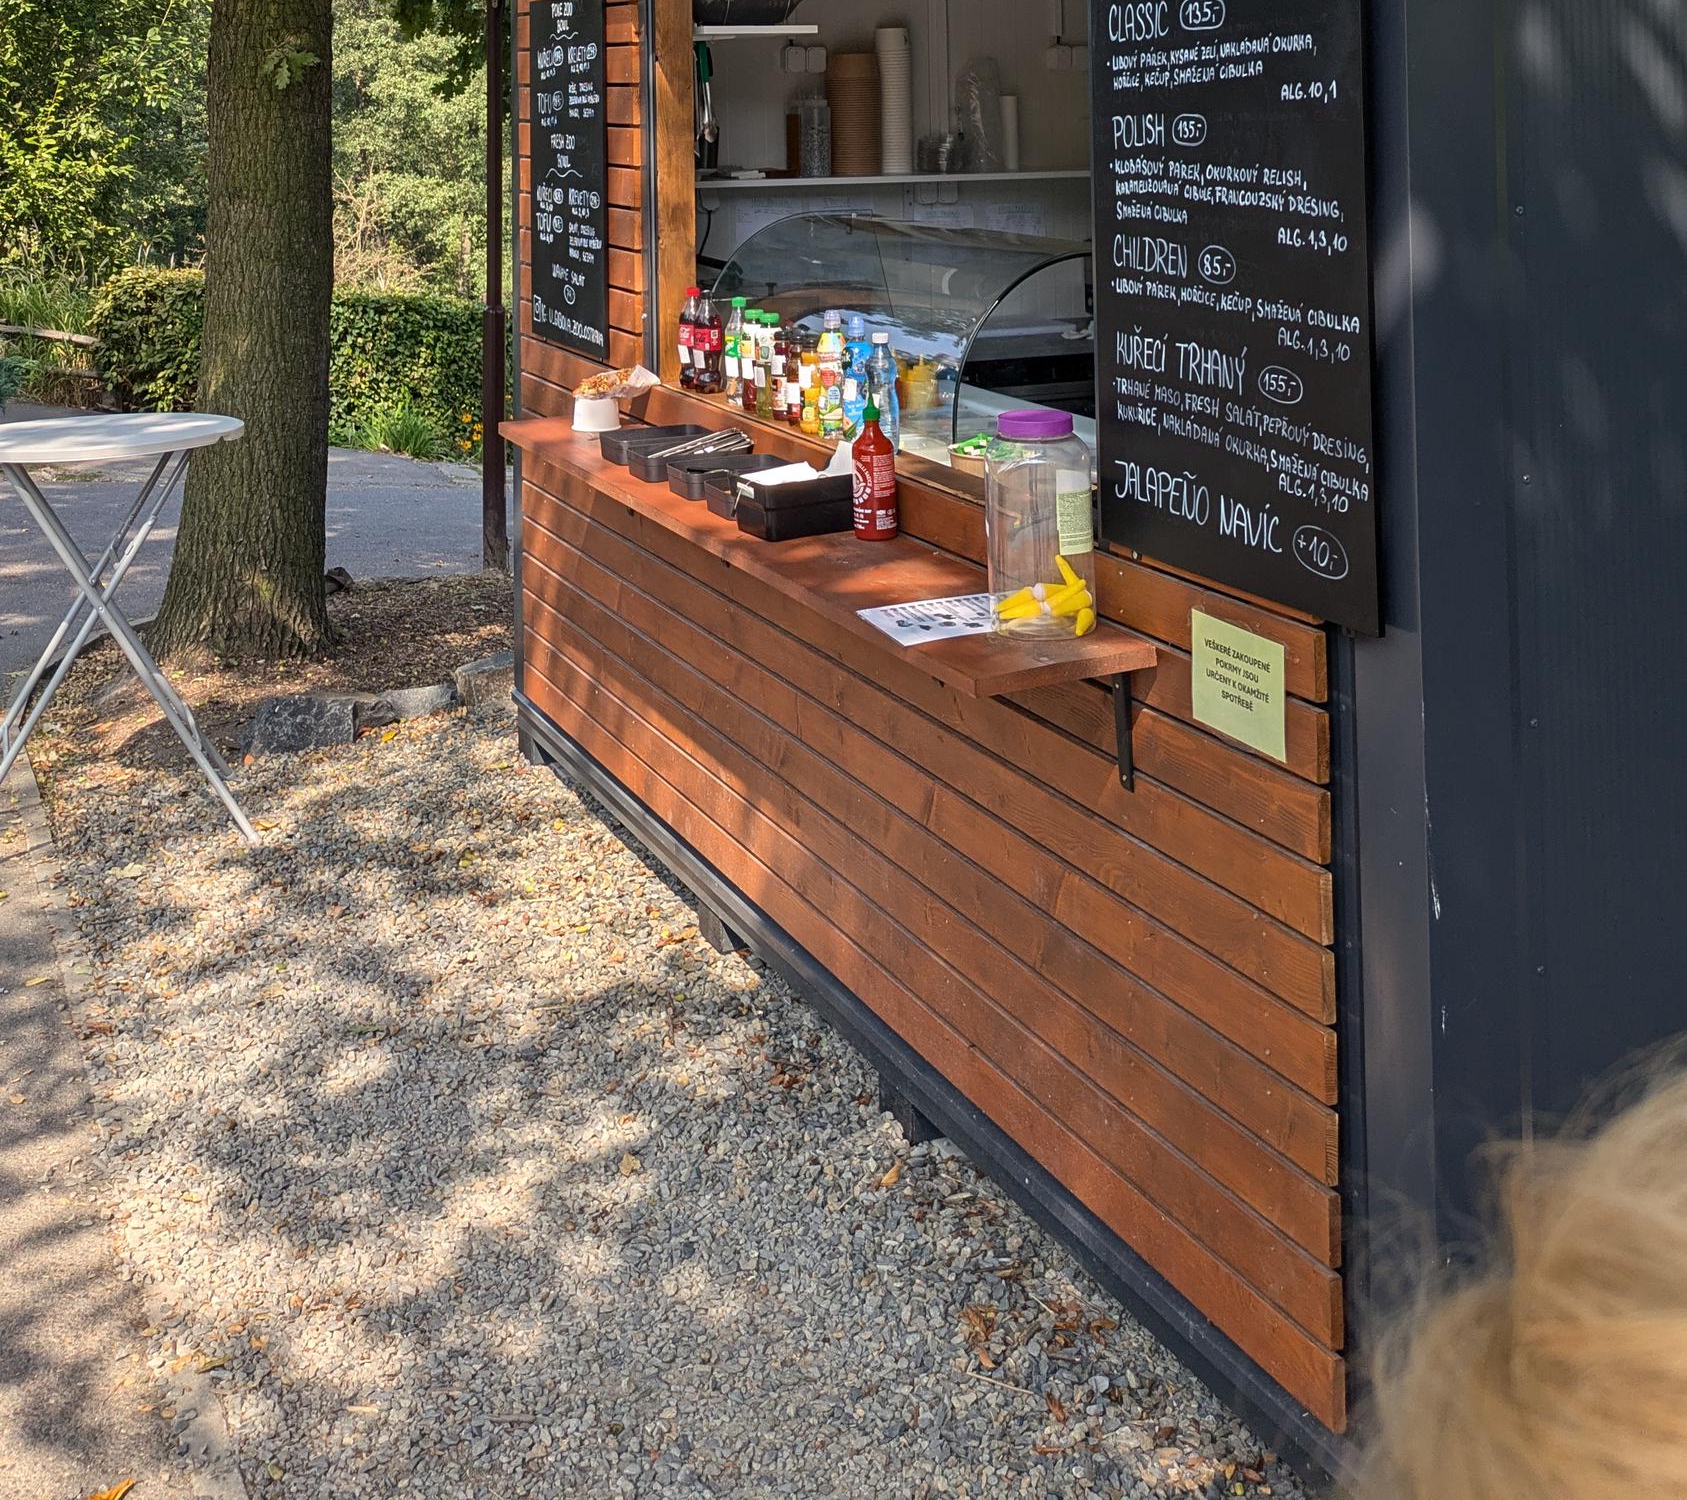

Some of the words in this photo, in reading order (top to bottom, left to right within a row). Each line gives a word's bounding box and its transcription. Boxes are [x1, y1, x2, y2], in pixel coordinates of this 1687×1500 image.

[1108, 0, 1170, 43] CLASSIC
[1219, 61, 1263, 80] CIBULKA
[1112, 113, 1165, 150] POLISH
[1115, 154, 1166, 176] KLOBÁSOVÝ
[1206, 163, 1259, 184] OKURKOVÝ
[1116, 199, 1153, 221] SMAŽENÁ
[1154, 207, 1188, 225] CIBULKA
[1215, 186, 1286, 212] FRANCOUZSKÝ
[1113, 234, 1188, 279] CHILDREN
[1116, 276, 1144, 295] LIBOVÝ
[1256, 299, 1304, 323] SMAŽENÁ
[1307, 308, 1360, 334] CIBULKA
[1116, 325, 1170, 372] KUŘECÍ
[1175, 341, 1248, 396] TRHANÝ
[1116, 378, 1152, 400] TRHANÉ
[1185, 392, 1220, 419] FRESH
[1263, 413, 1312, 448] PEPŘOVÝ
[1162, 411, 1223, 448] NAKLÁDANÁ
[1270, 451, 1320, 481] SMAŽENÁ
[1320, 469, 1369, 501] CIBULKA
[1114, 459, 1210, 526] JALAPEÑO
[1219, 494, 1283, 553] NAVÍC
[1204, 637, 1232, 657] VEŠKERÉ
[1231, 649, 1271, 673] ZAKOUPENÉ
[1215, 657, 1242, 677] POKRMY
[1242, 669, 1259, 683] JSOU
[1205, 668, 1232, 687] URČENY
[1232, 680, 1238, 689] K
[1237, 681, 1270, 704] OKAMŽITÉ
[1221, 690, 1253, 712] SPOTŘEBĚ
